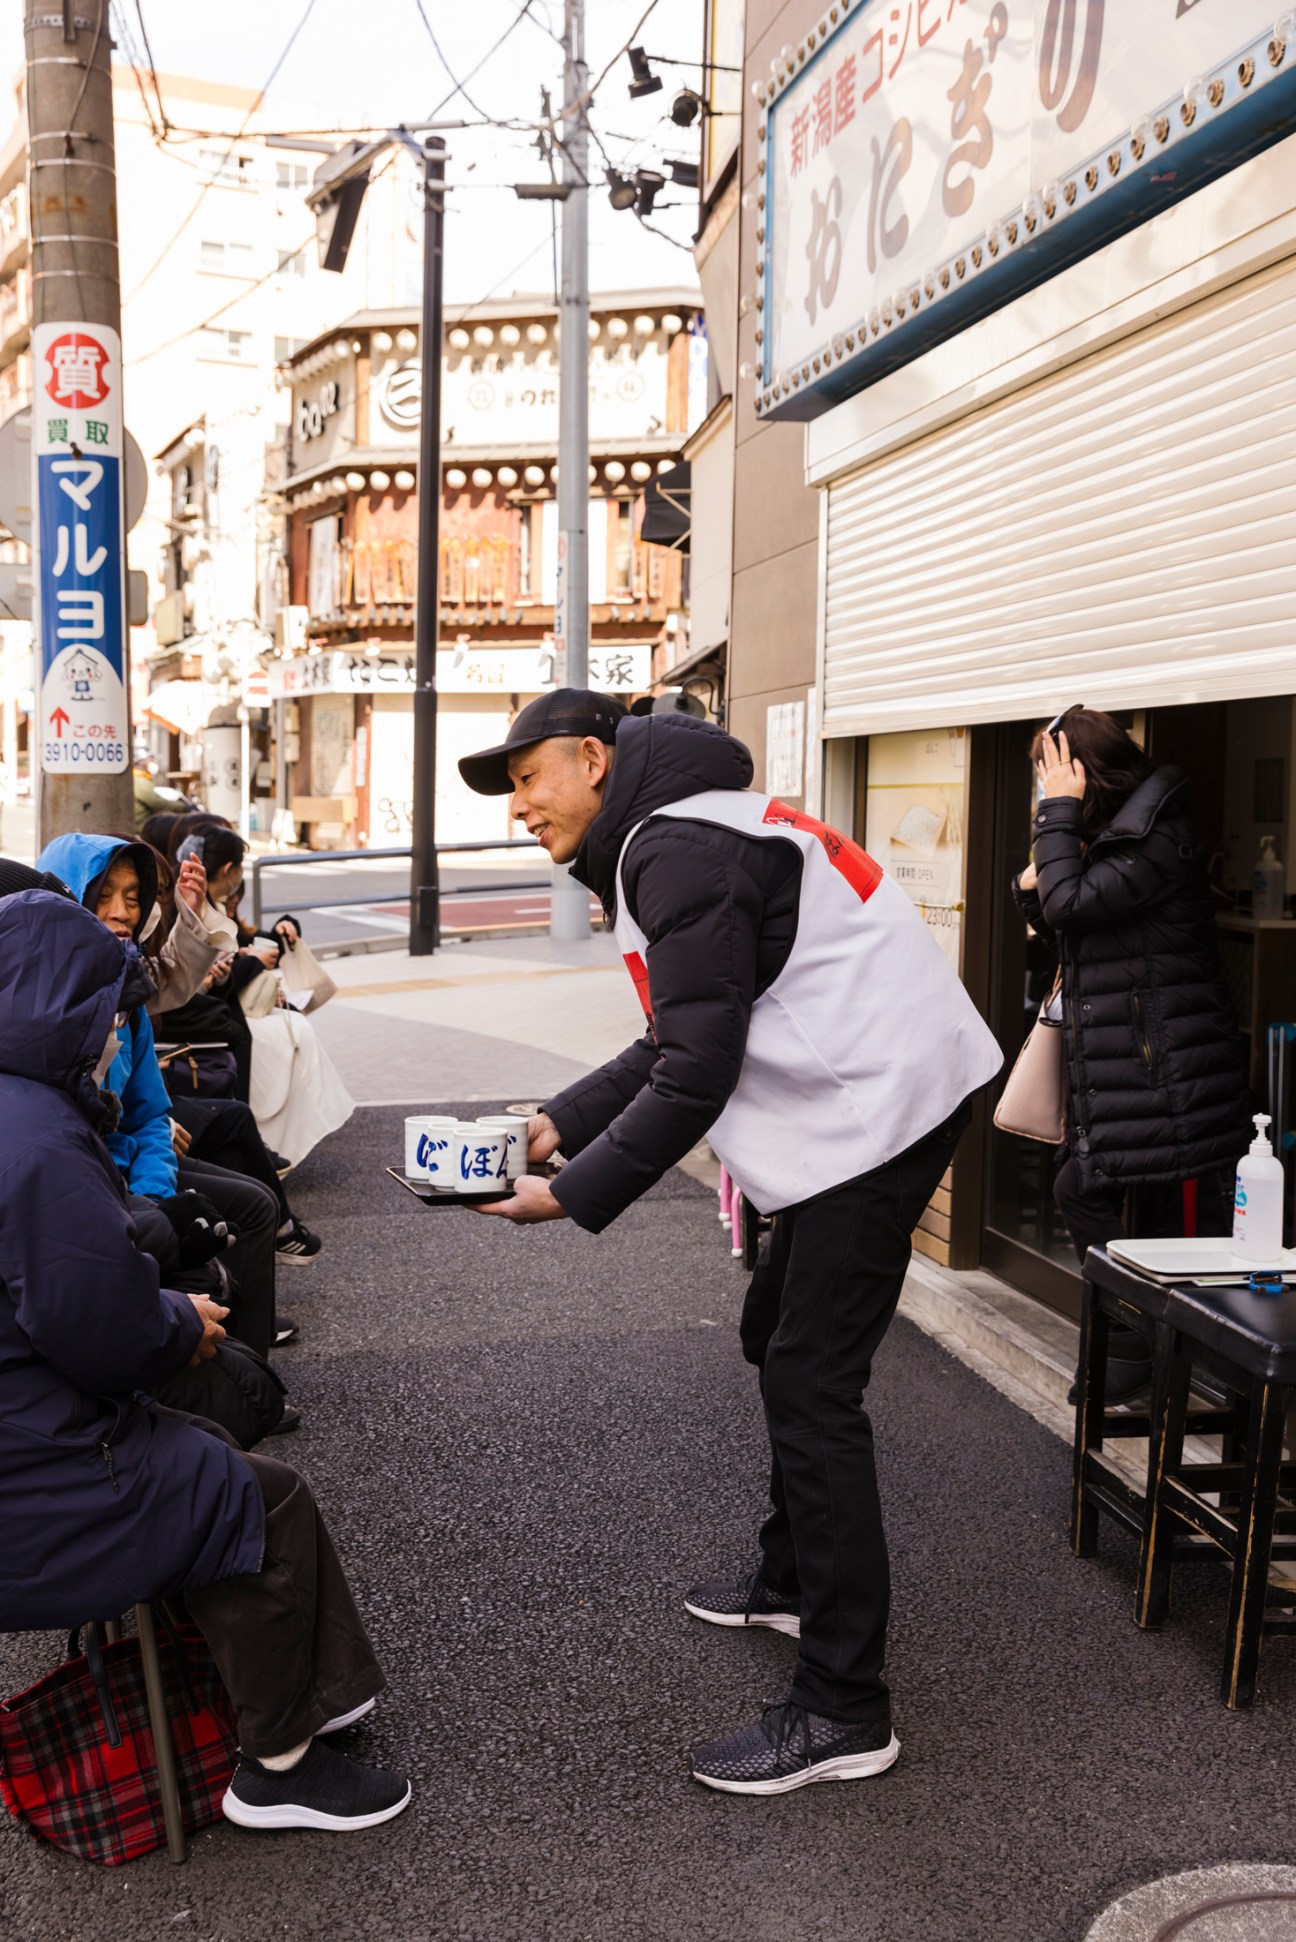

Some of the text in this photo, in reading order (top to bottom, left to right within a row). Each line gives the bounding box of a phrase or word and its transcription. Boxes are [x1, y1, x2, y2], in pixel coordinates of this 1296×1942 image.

[790, 0, 969, 178] 新潟産コシヒ
[52, 344, 101, 399] 質
[47, 417, 109, 446] 買取
[51, 459, 108, 640] マルヨ
[45, 743, 124, 763] 3910-0066
[73, 724, 117, 740] この先
